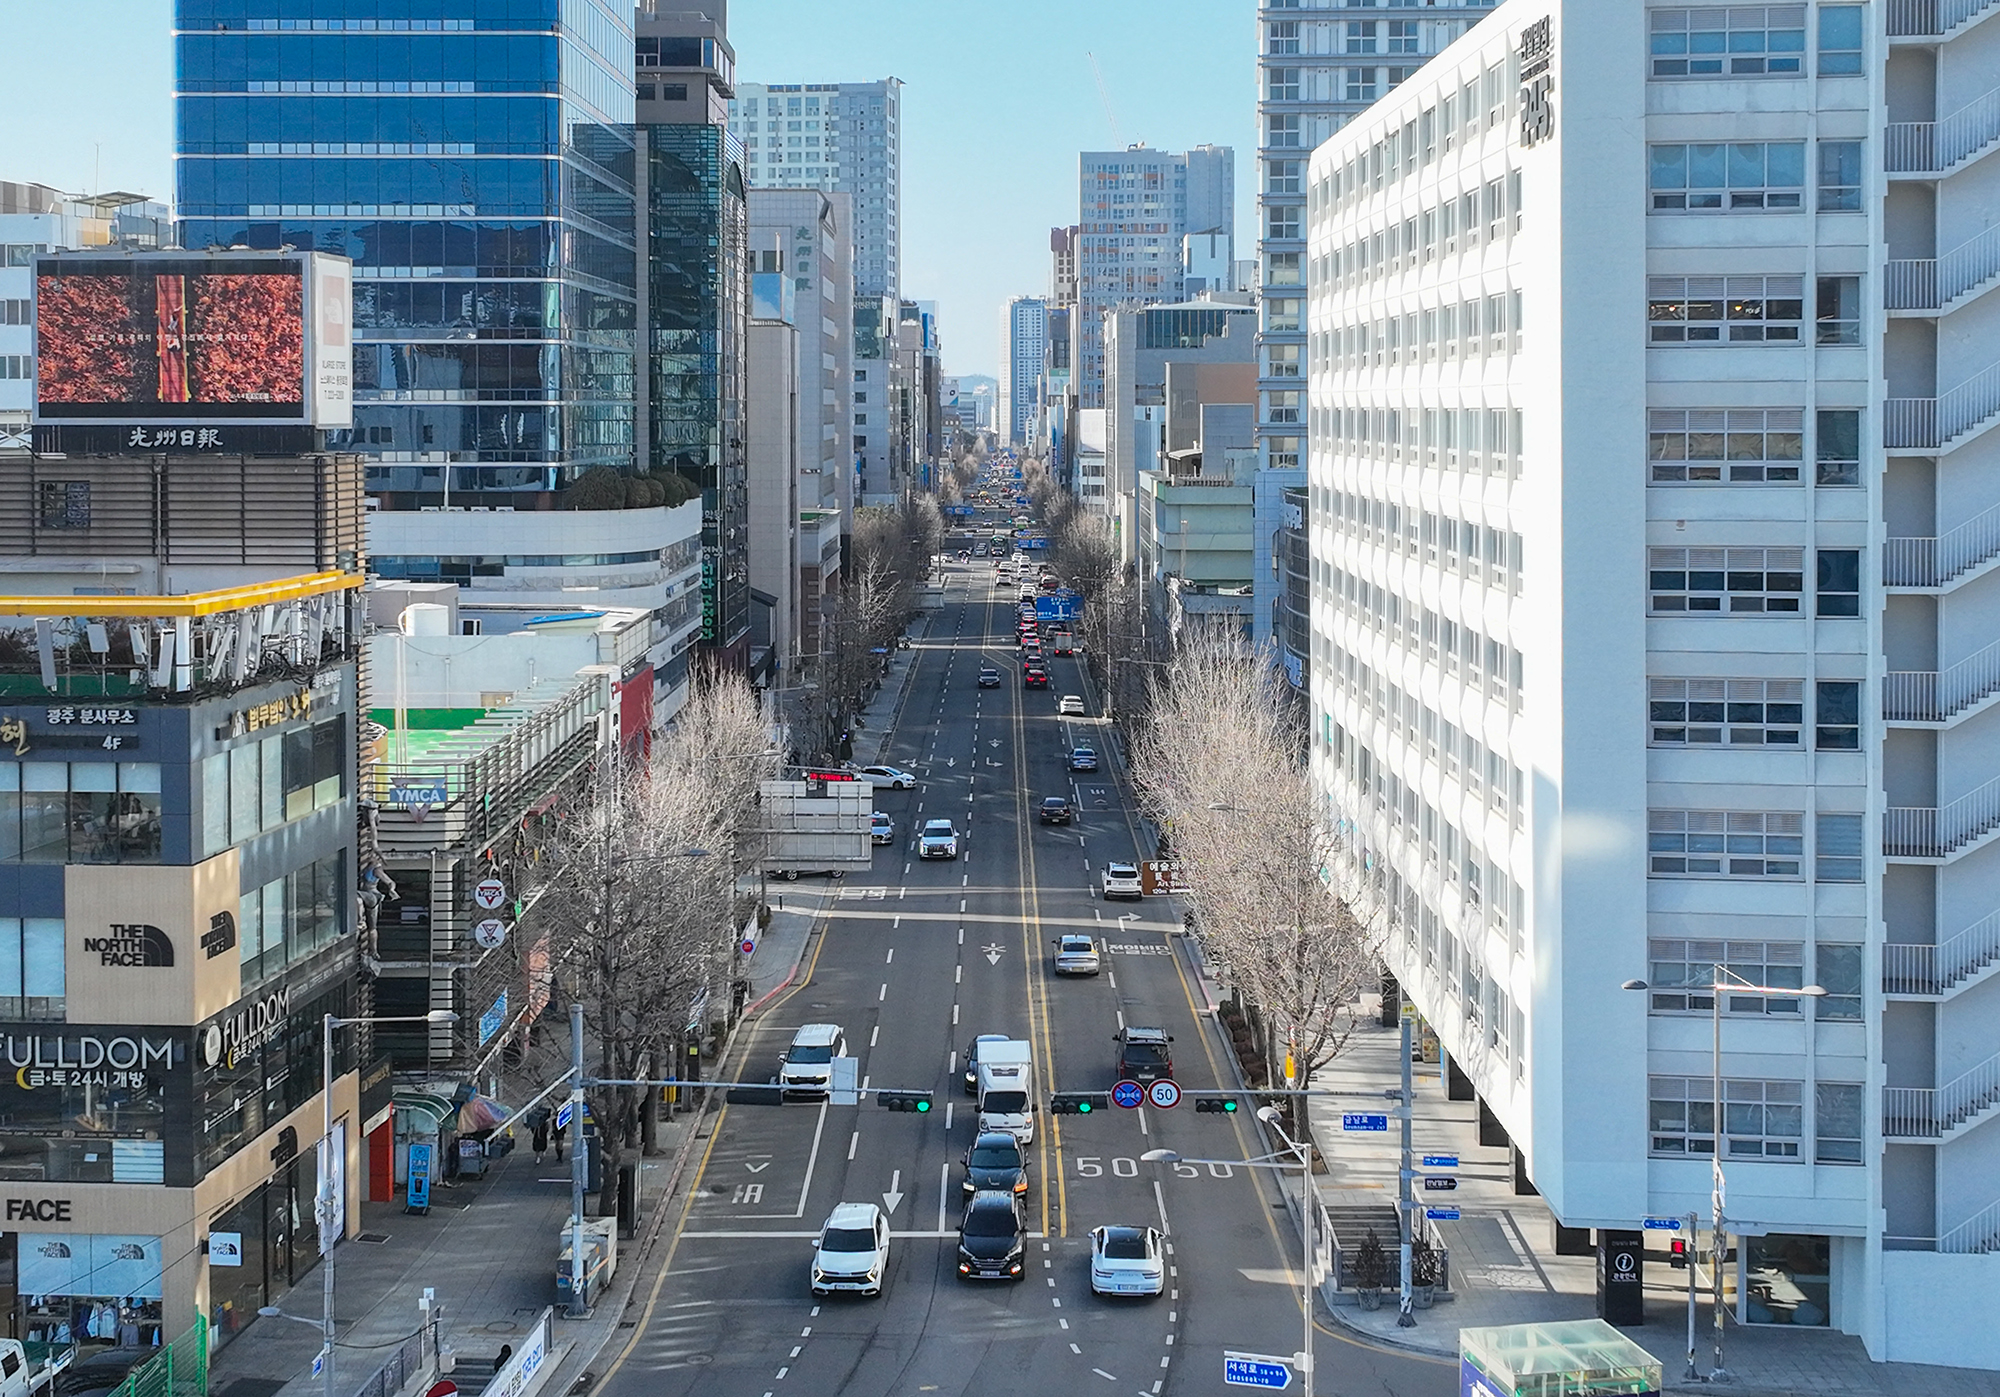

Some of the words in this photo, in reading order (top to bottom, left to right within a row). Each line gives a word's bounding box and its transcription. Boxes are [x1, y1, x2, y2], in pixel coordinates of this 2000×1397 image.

[1520, 74, 1550, 147] 245
[128, 426, 224, 449] 光州日報
[47, 707, 75, 724] 광주
[80, 708, 135, 724] 분사무소
[247, 697, 288, 732] 법무법인
[102, 735, 121, 750] 4F
[395, 788, 442, 803] YMCA
[478, 889, 501, 898] YMCA
[109, 924, 143, 938] THE
[84, 938, 143, 952] NORTH
[1108, 943, 1172, 957] 전일빌딩
[101, 952, 143, 967] FACE
[223, 984, 290, 1055] FULLDOM
[0, 1033, 172, 1070] ULLDOM
[71, 1071, 107, 1087] 24시
[113, 1071, 145, 1088] 개방
[1156, 1088, 1173, 1101] 50
[1344, 1116, 1369, 1125] 금남로
[1077, 1157, 1138, 1178] 50
[1172, 1162, 1233, 1178] 50
[6, 1199, 72, 1222] FACE
[1228, 1362, 1257, 1374] 서석로
[1228, 1373, 1269, 1384] Seoseok-ro
